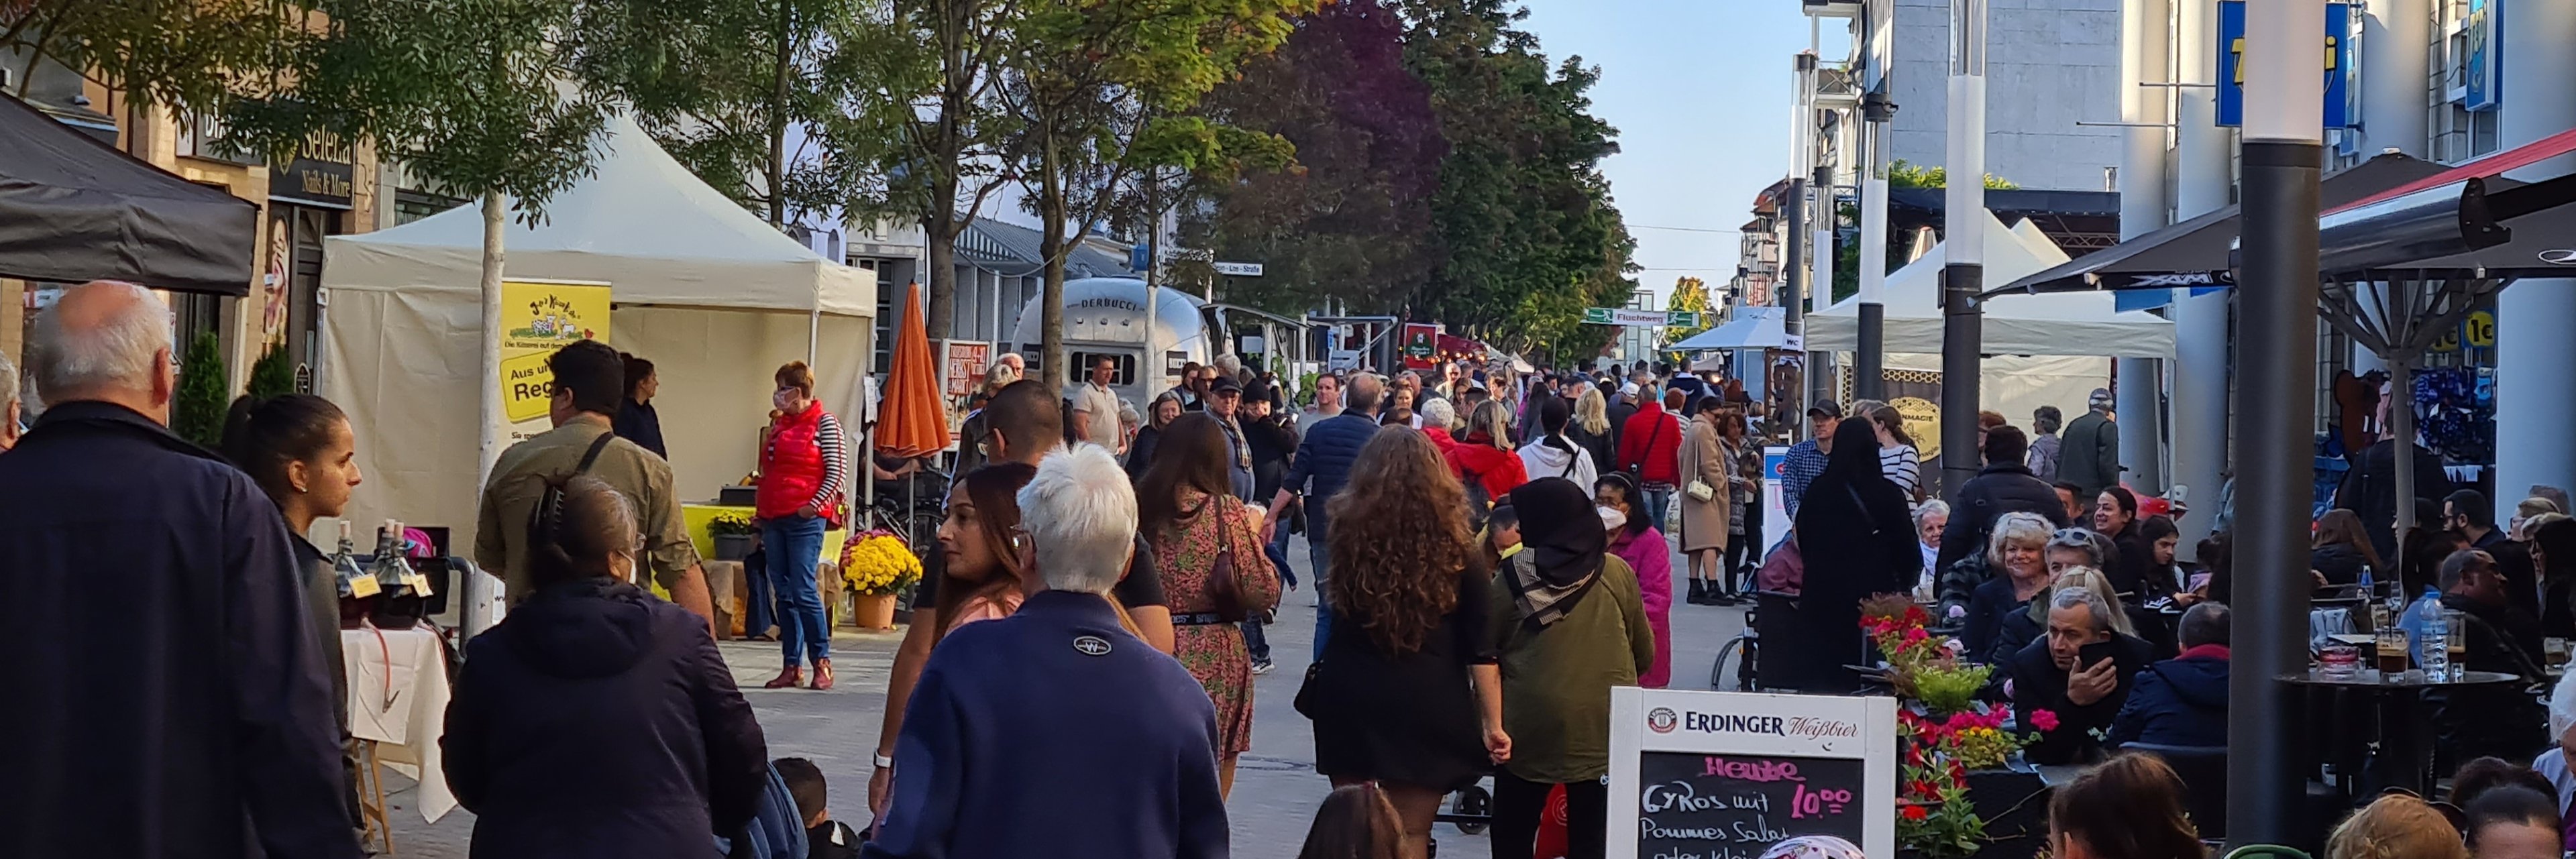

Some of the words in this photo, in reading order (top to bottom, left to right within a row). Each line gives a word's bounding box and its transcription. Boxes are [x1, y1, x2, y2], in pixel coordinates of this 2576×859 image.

[302, 170, 321, 194] Nails
[323, 172, 329, 194] &
[331, 174, 350, 197] More
[1617, 313, 1664, 323] Fluchtweg
[511, 368, 534, 380] Aus
[514, 380, 553, 402] Reg
[1902, 414, 1934, 422] NMAGIE
[1686, 711, 1786, 736] ERDINGER
[1788, 716, 1858, 740] Weißbier
[1702, 756, 1807, 782] Heute
[1733, 791, 1770, 813] mit
[1640, 817, 1728, 840] Pommes
